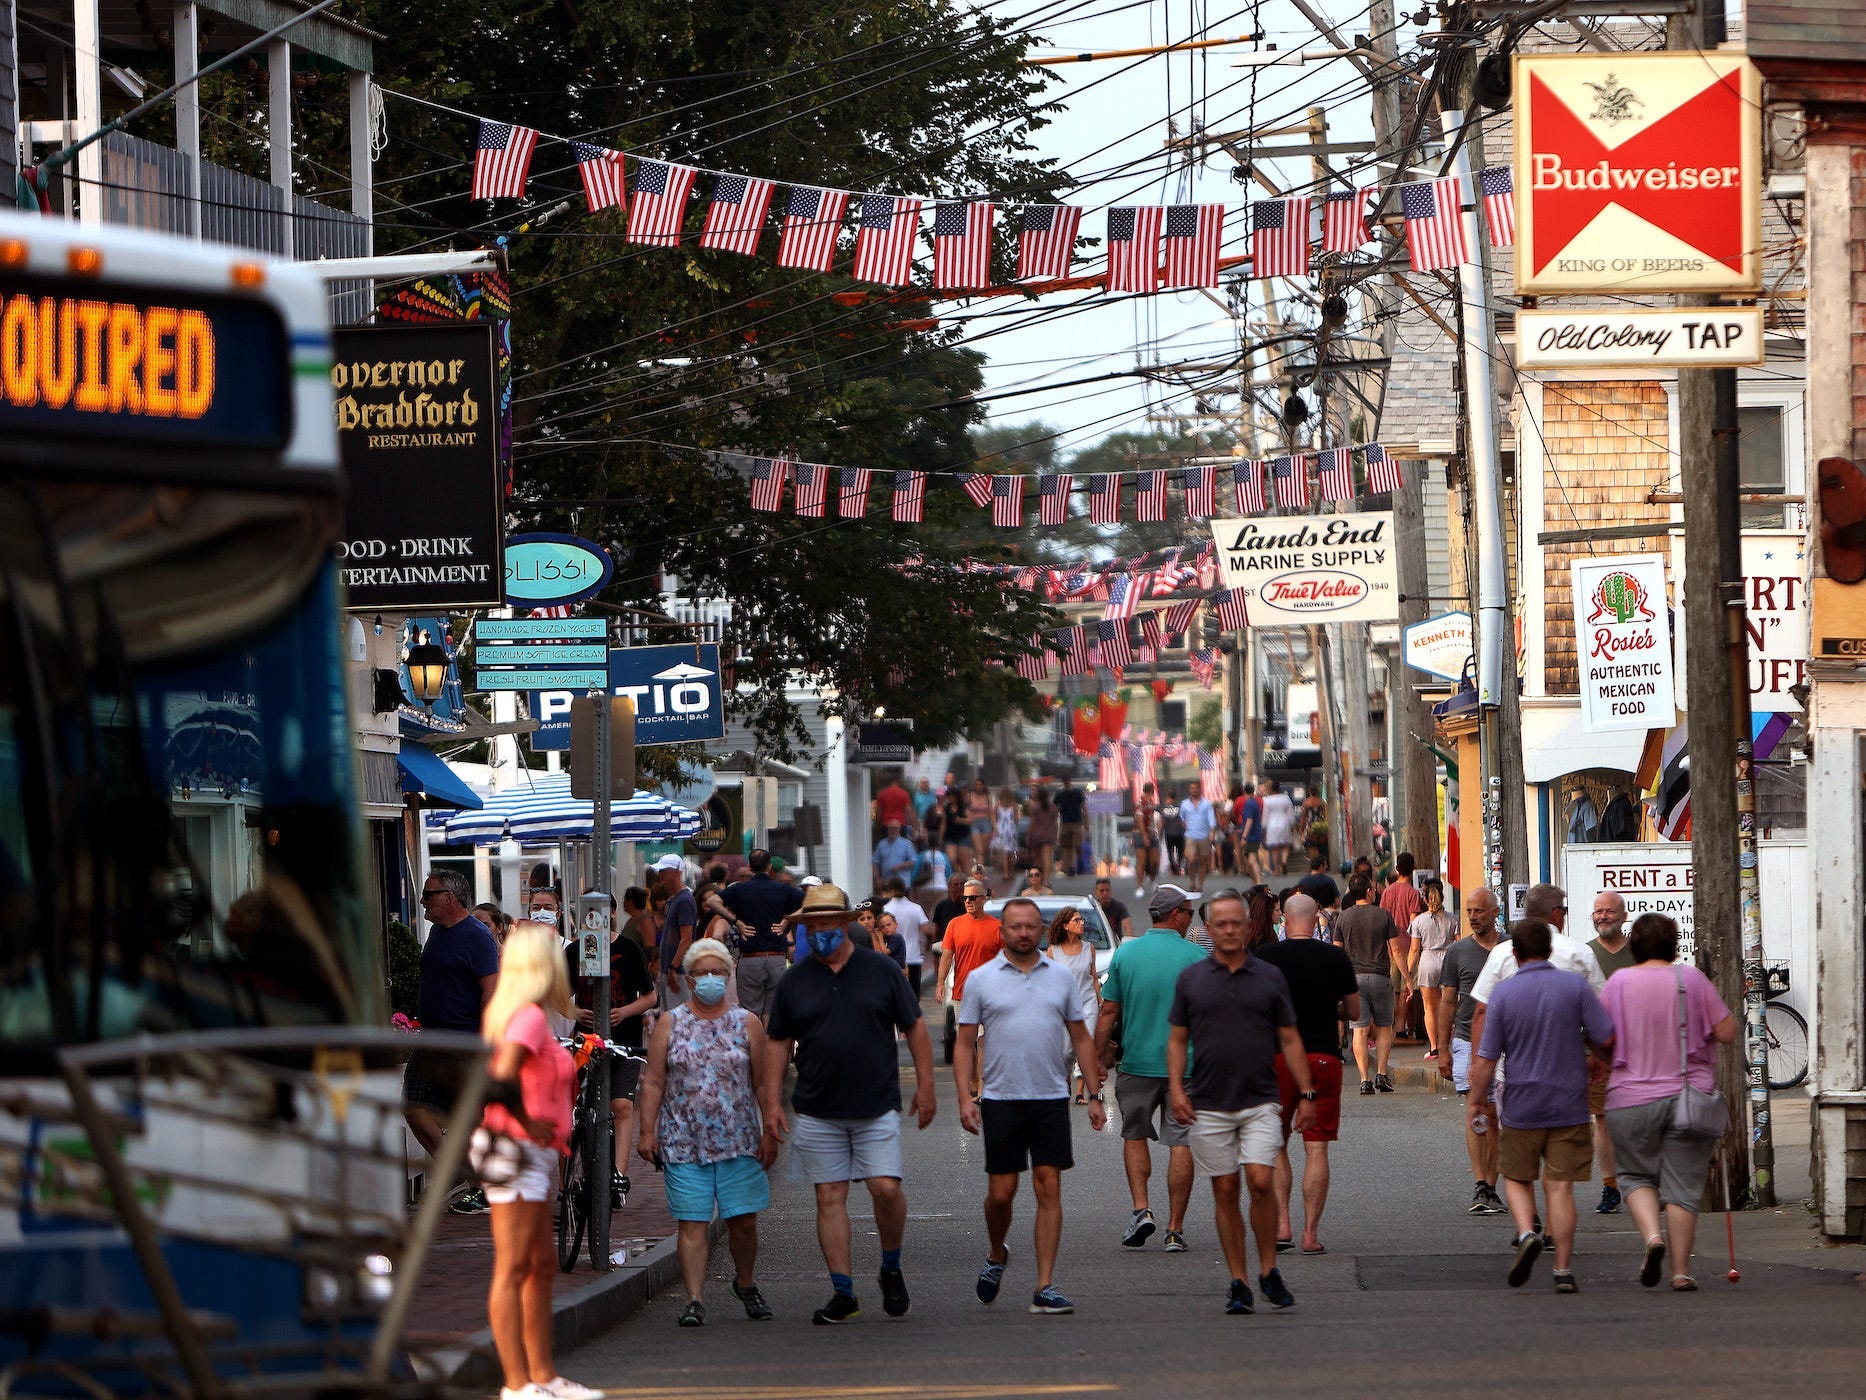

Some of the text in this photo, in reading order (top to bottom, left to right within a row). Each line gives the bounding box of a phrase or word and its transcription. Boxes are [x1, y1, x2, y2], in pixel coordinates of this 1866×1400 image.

[1533, 153, 1739, 191] Budweiser
[1558, 257, 1704, 272] KING OF BEERS
[1538, 322, 1744, 355] Old Colony TAP
[0, 292, 216, 420] QUIRED
[331, 359, 465, 389] overnor
[334, 388, 478, 431] Bradford
[368, 432, 477, 448] RESTAURANT
[1226, 520, 1386, 552] Lands End
[335, 537, 474, 560] OOD DRINK
[1230, 549, 1386, 571] MARINE SUPPLY
[339, 564, 490, 586] TERTAINMENT
[1244, 588, 1257, 597] ST.
[480, 624, 602, 635] HAND MADE FROZEN YOGURT
[1413, 629, 1465, 648] KENNETH
[1591, 628, 1657, 661] Rosie's
[478, 650, 606, 661] PREMIUM SOFT ICE CREAM
[480, 675, 603, 685] FRESH FRUIT SMOOTHIES
[1590, 662, 1662, 680] AUTHENTIC
[1599, 682, 1656, 699] MEXICAN
[539, 682, 711, 721] PTIO
[1611, 701, 1646, 716] FOOD
[637, 713, 709, 724] COCKTAIL BAR
[1603, 869, 1662, 888] RENT
[1666, 873, 1677, 887] a
[1627, 900, 1685, 912] UR DAY
